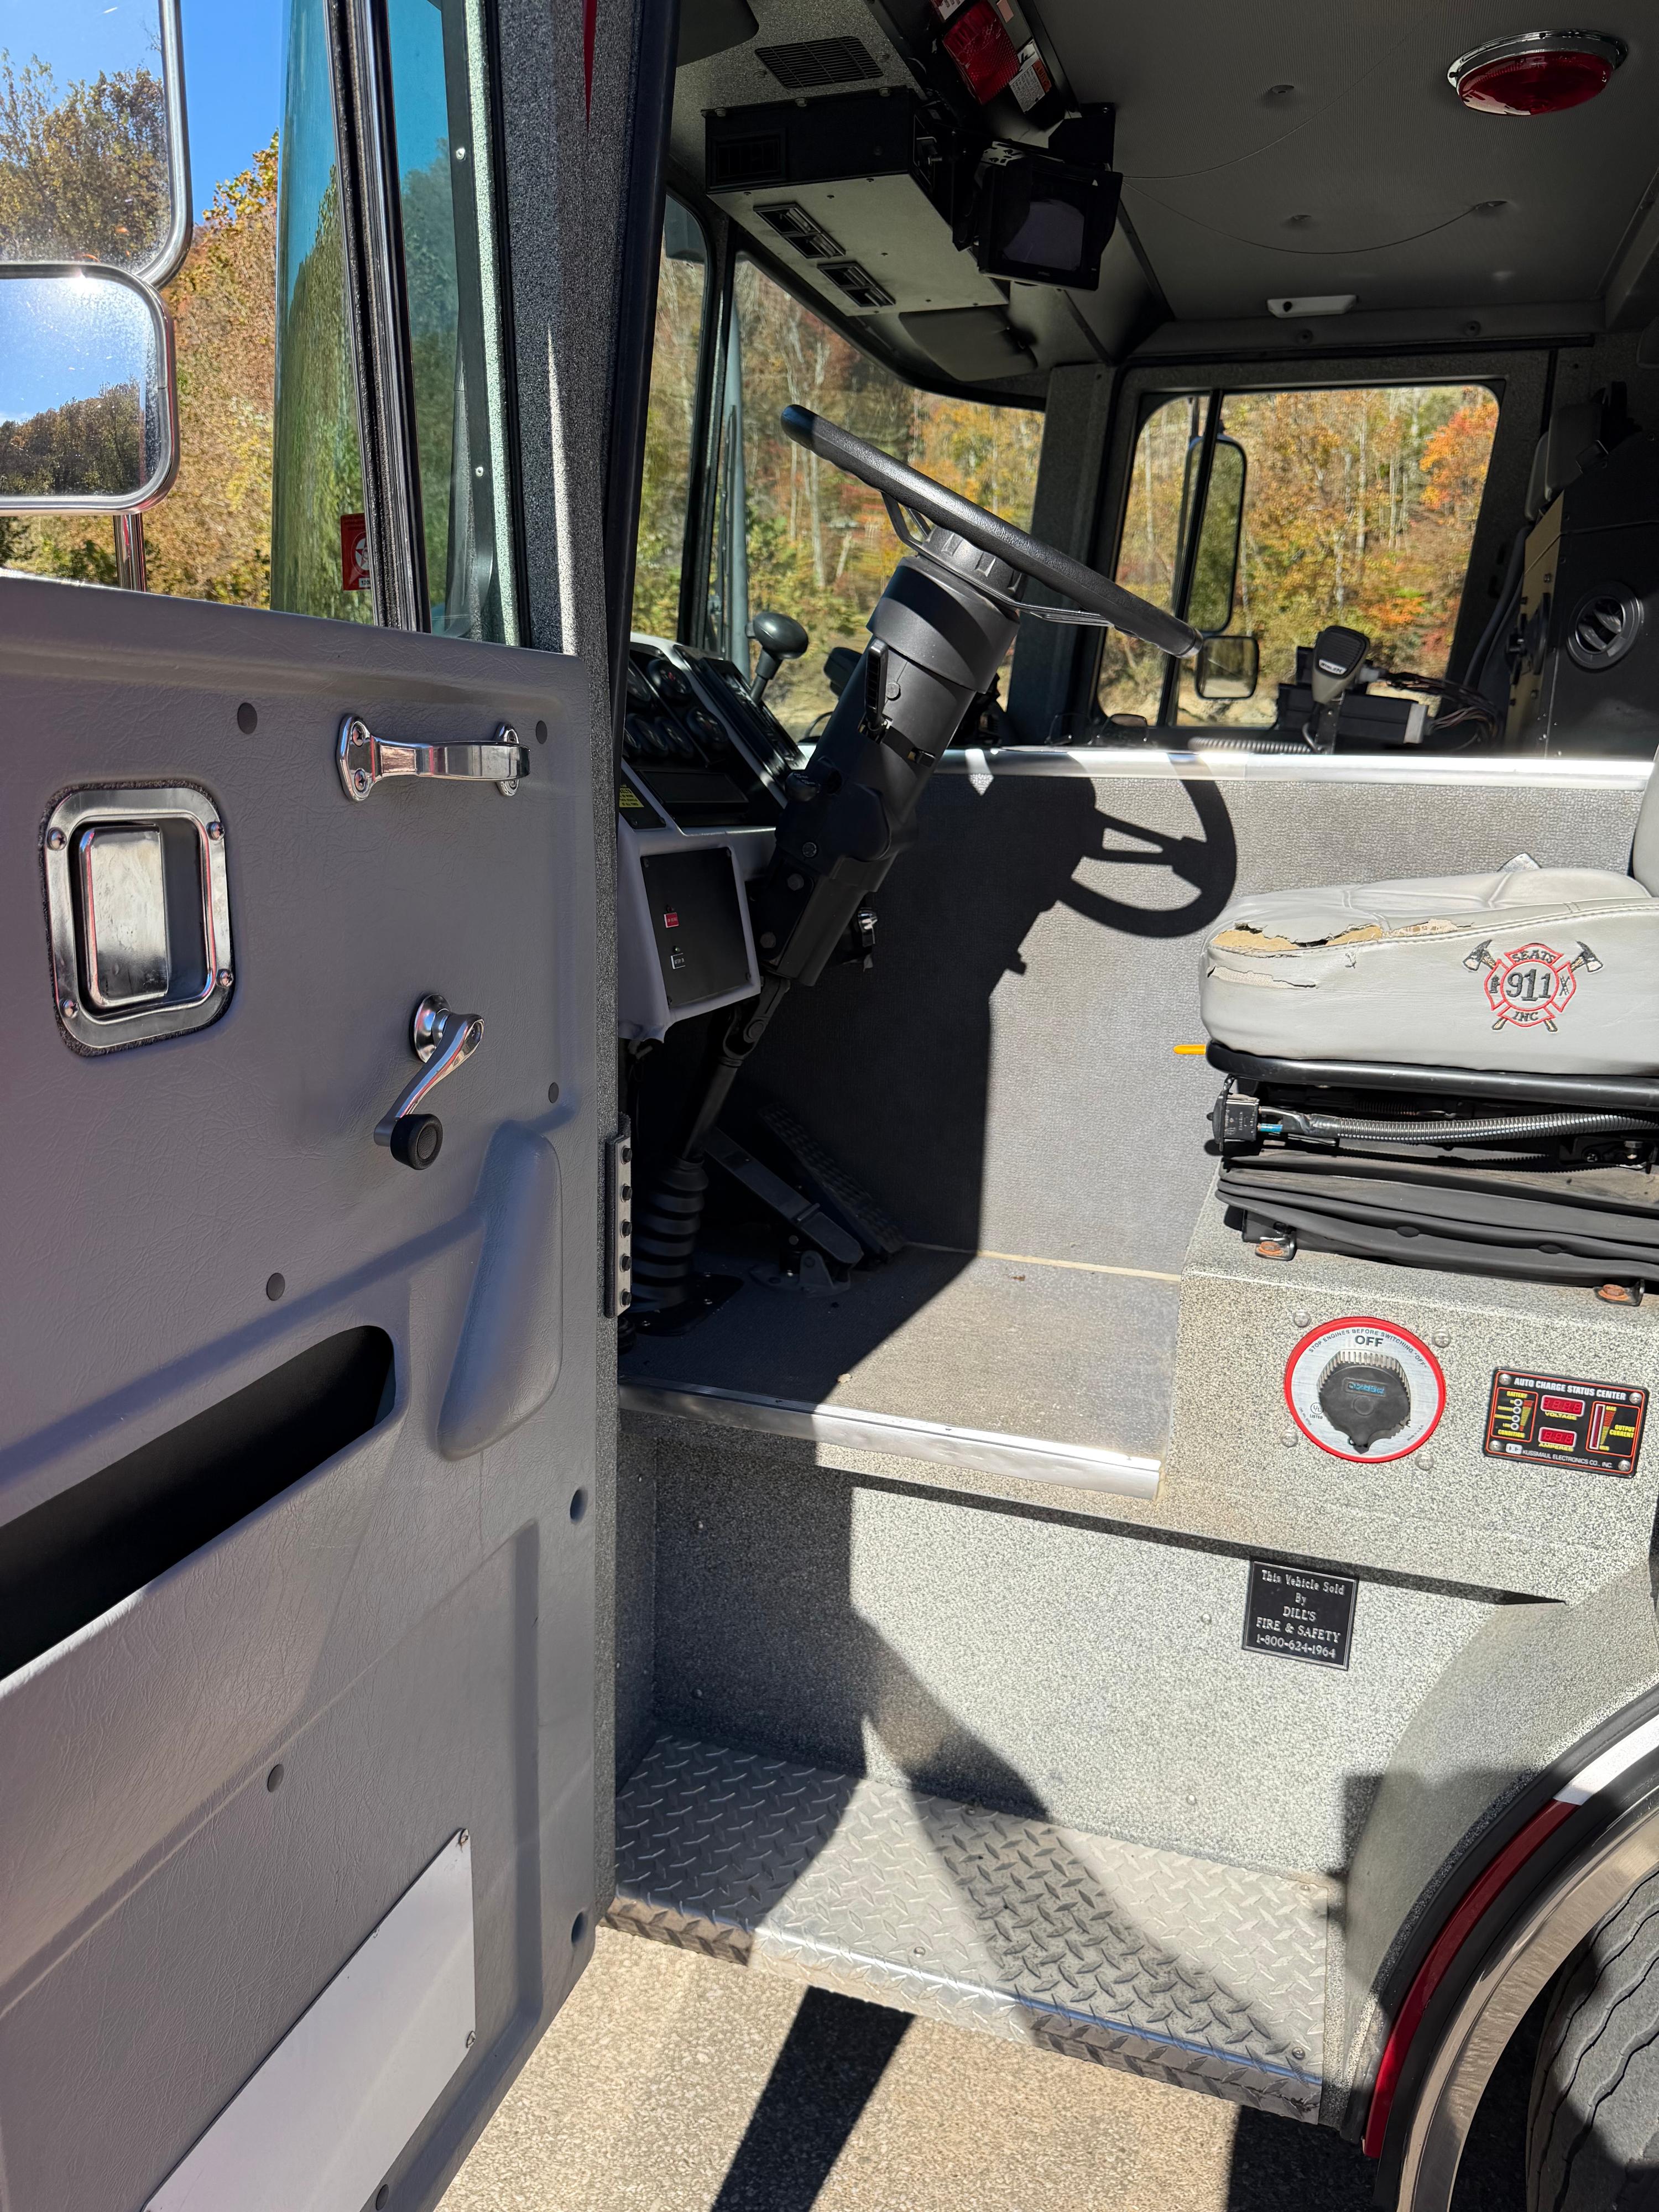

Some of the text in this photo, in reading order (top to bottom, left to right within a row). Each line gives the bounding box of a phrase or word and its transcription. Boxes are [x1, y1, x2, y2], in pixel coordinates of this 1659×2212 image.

[1512, 950, 1556, 963] SEATS
[1506, 968, 1551, 1001] 911
[1512, 1011, 1538, 1021] INC
[1308, 1340, 1322, 1353] STOP
[1323, 1329, 1350, 1342] ENGINES
[1380, 1332, 1413, 1353] SWITCHING
[1354, 1335, 1384, 1347] OFF
[1514, 1378, 1626, 1401] AUTO CHARGE STATUS CENTER
[1545, 1411, 1577, 1420] VOLTAGE
[1609, 1429, 1634, 1438] CURRENT
[1522, 1449, 1551, 1459] KUSSMAUL
[1552, 1454, 1589, 1464] ELECTRONICS
[1261, 1569, 1345, 1596] This Vehicle Sold
[1295, 1592, 1307, 1606] By
[1282, 1606, 1317, 1622] DILL'S
[1256, 1616, 1342, 1644] FIRE & SAFETY
[1256, 1634, 1337, 1658] 1-800-624-1964
